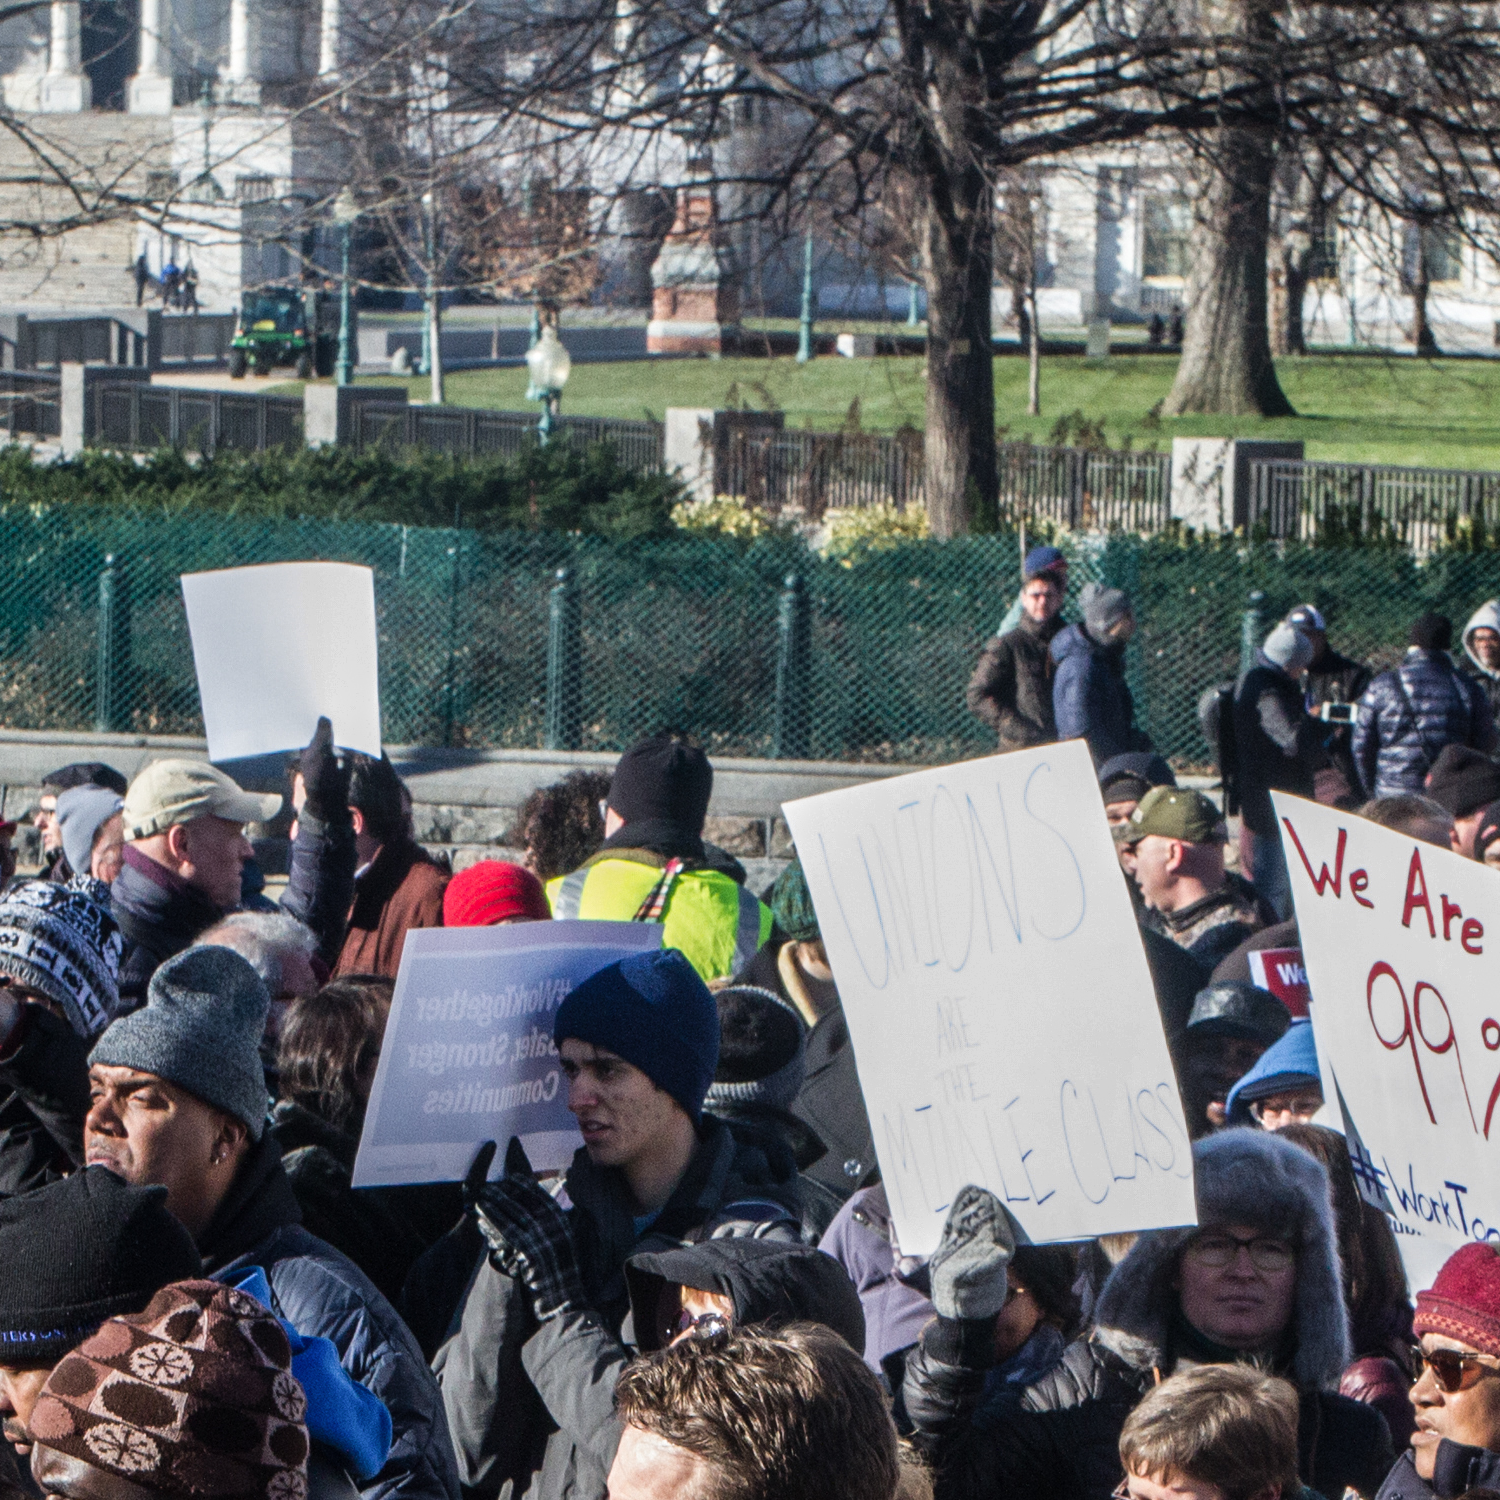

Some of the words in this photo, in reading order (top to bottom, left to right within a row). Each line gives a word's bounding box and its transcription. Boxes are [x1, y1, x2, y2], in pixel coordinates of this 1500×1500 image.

[818, 762, 1086, 990] UNIONS
[1281, 816, 1375, 909] We
[1402, 846, 1484, 955] Are
[936, 996, 980, 1058] ARE
[936, 1062, 990, 1104] THE
[1061, 1080, 1192, 1204] CLASS
